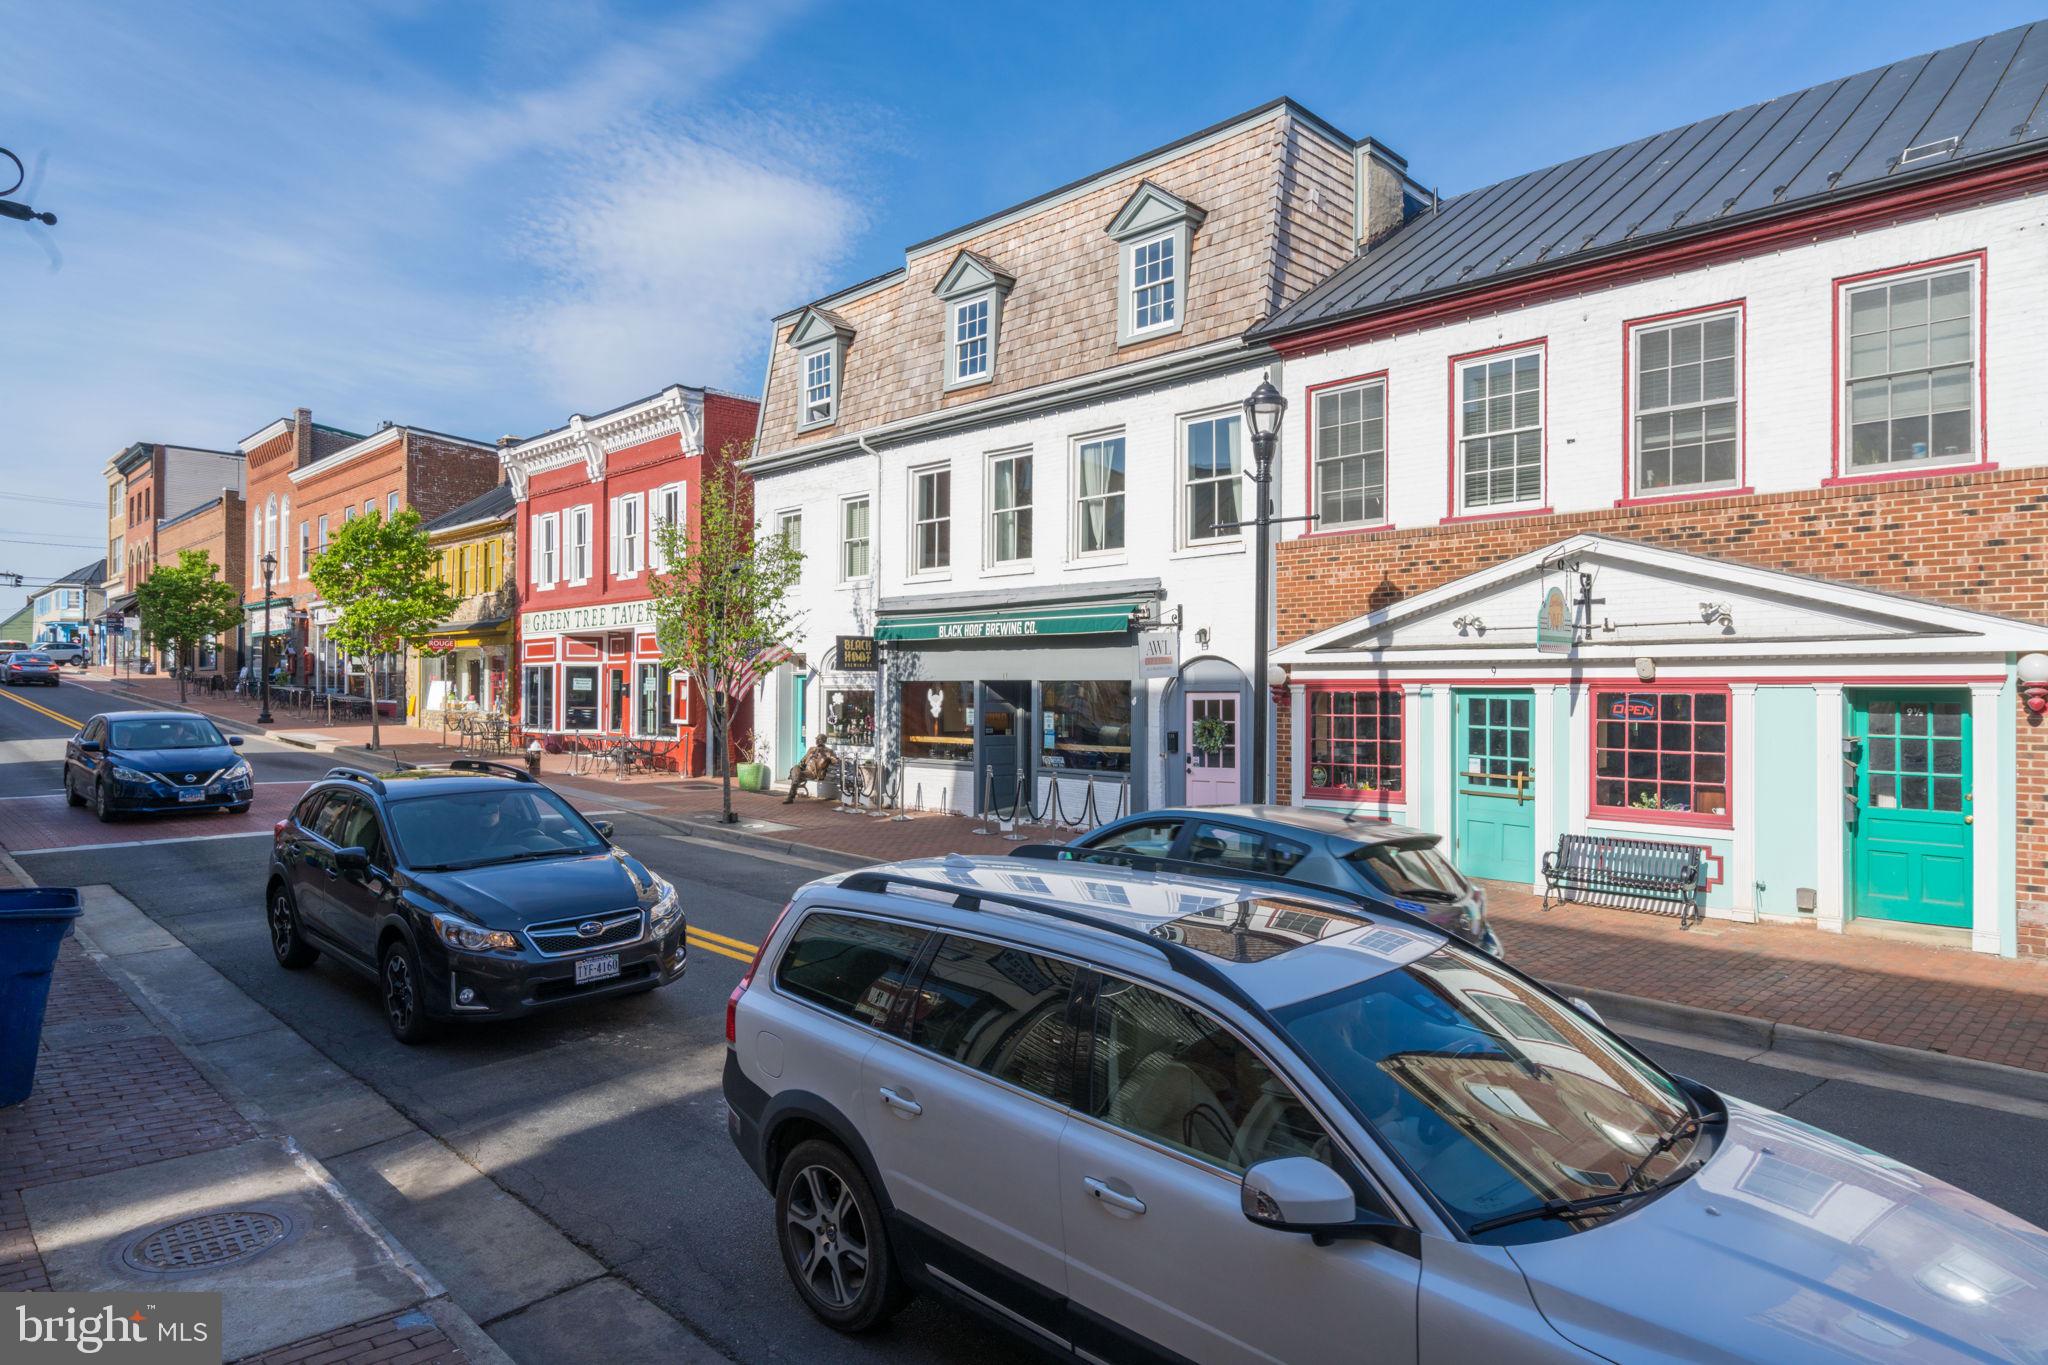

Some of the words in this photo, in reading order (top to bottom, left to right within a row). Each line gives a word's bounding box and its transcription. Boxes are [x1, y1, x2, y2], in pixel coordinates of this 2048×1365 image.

[533, 611, 570, 631] GREEN
[575, 608, 606, 628] TREE
[611, 602, 654, 624] TAVER
[939, 625, 963, 638] BLACK
[964, 623, 984, 637] HOOF
[985, 621, 1022, 636] BREWING
[1024, 620, 1038, 634] CO.
[844, 639, 872, 651] BLACK
[1145, 640, 1172, 656] AWL
[1612, 704, 1655, 716] OPEN
[577, 960, 618, 978] TYF-4160
